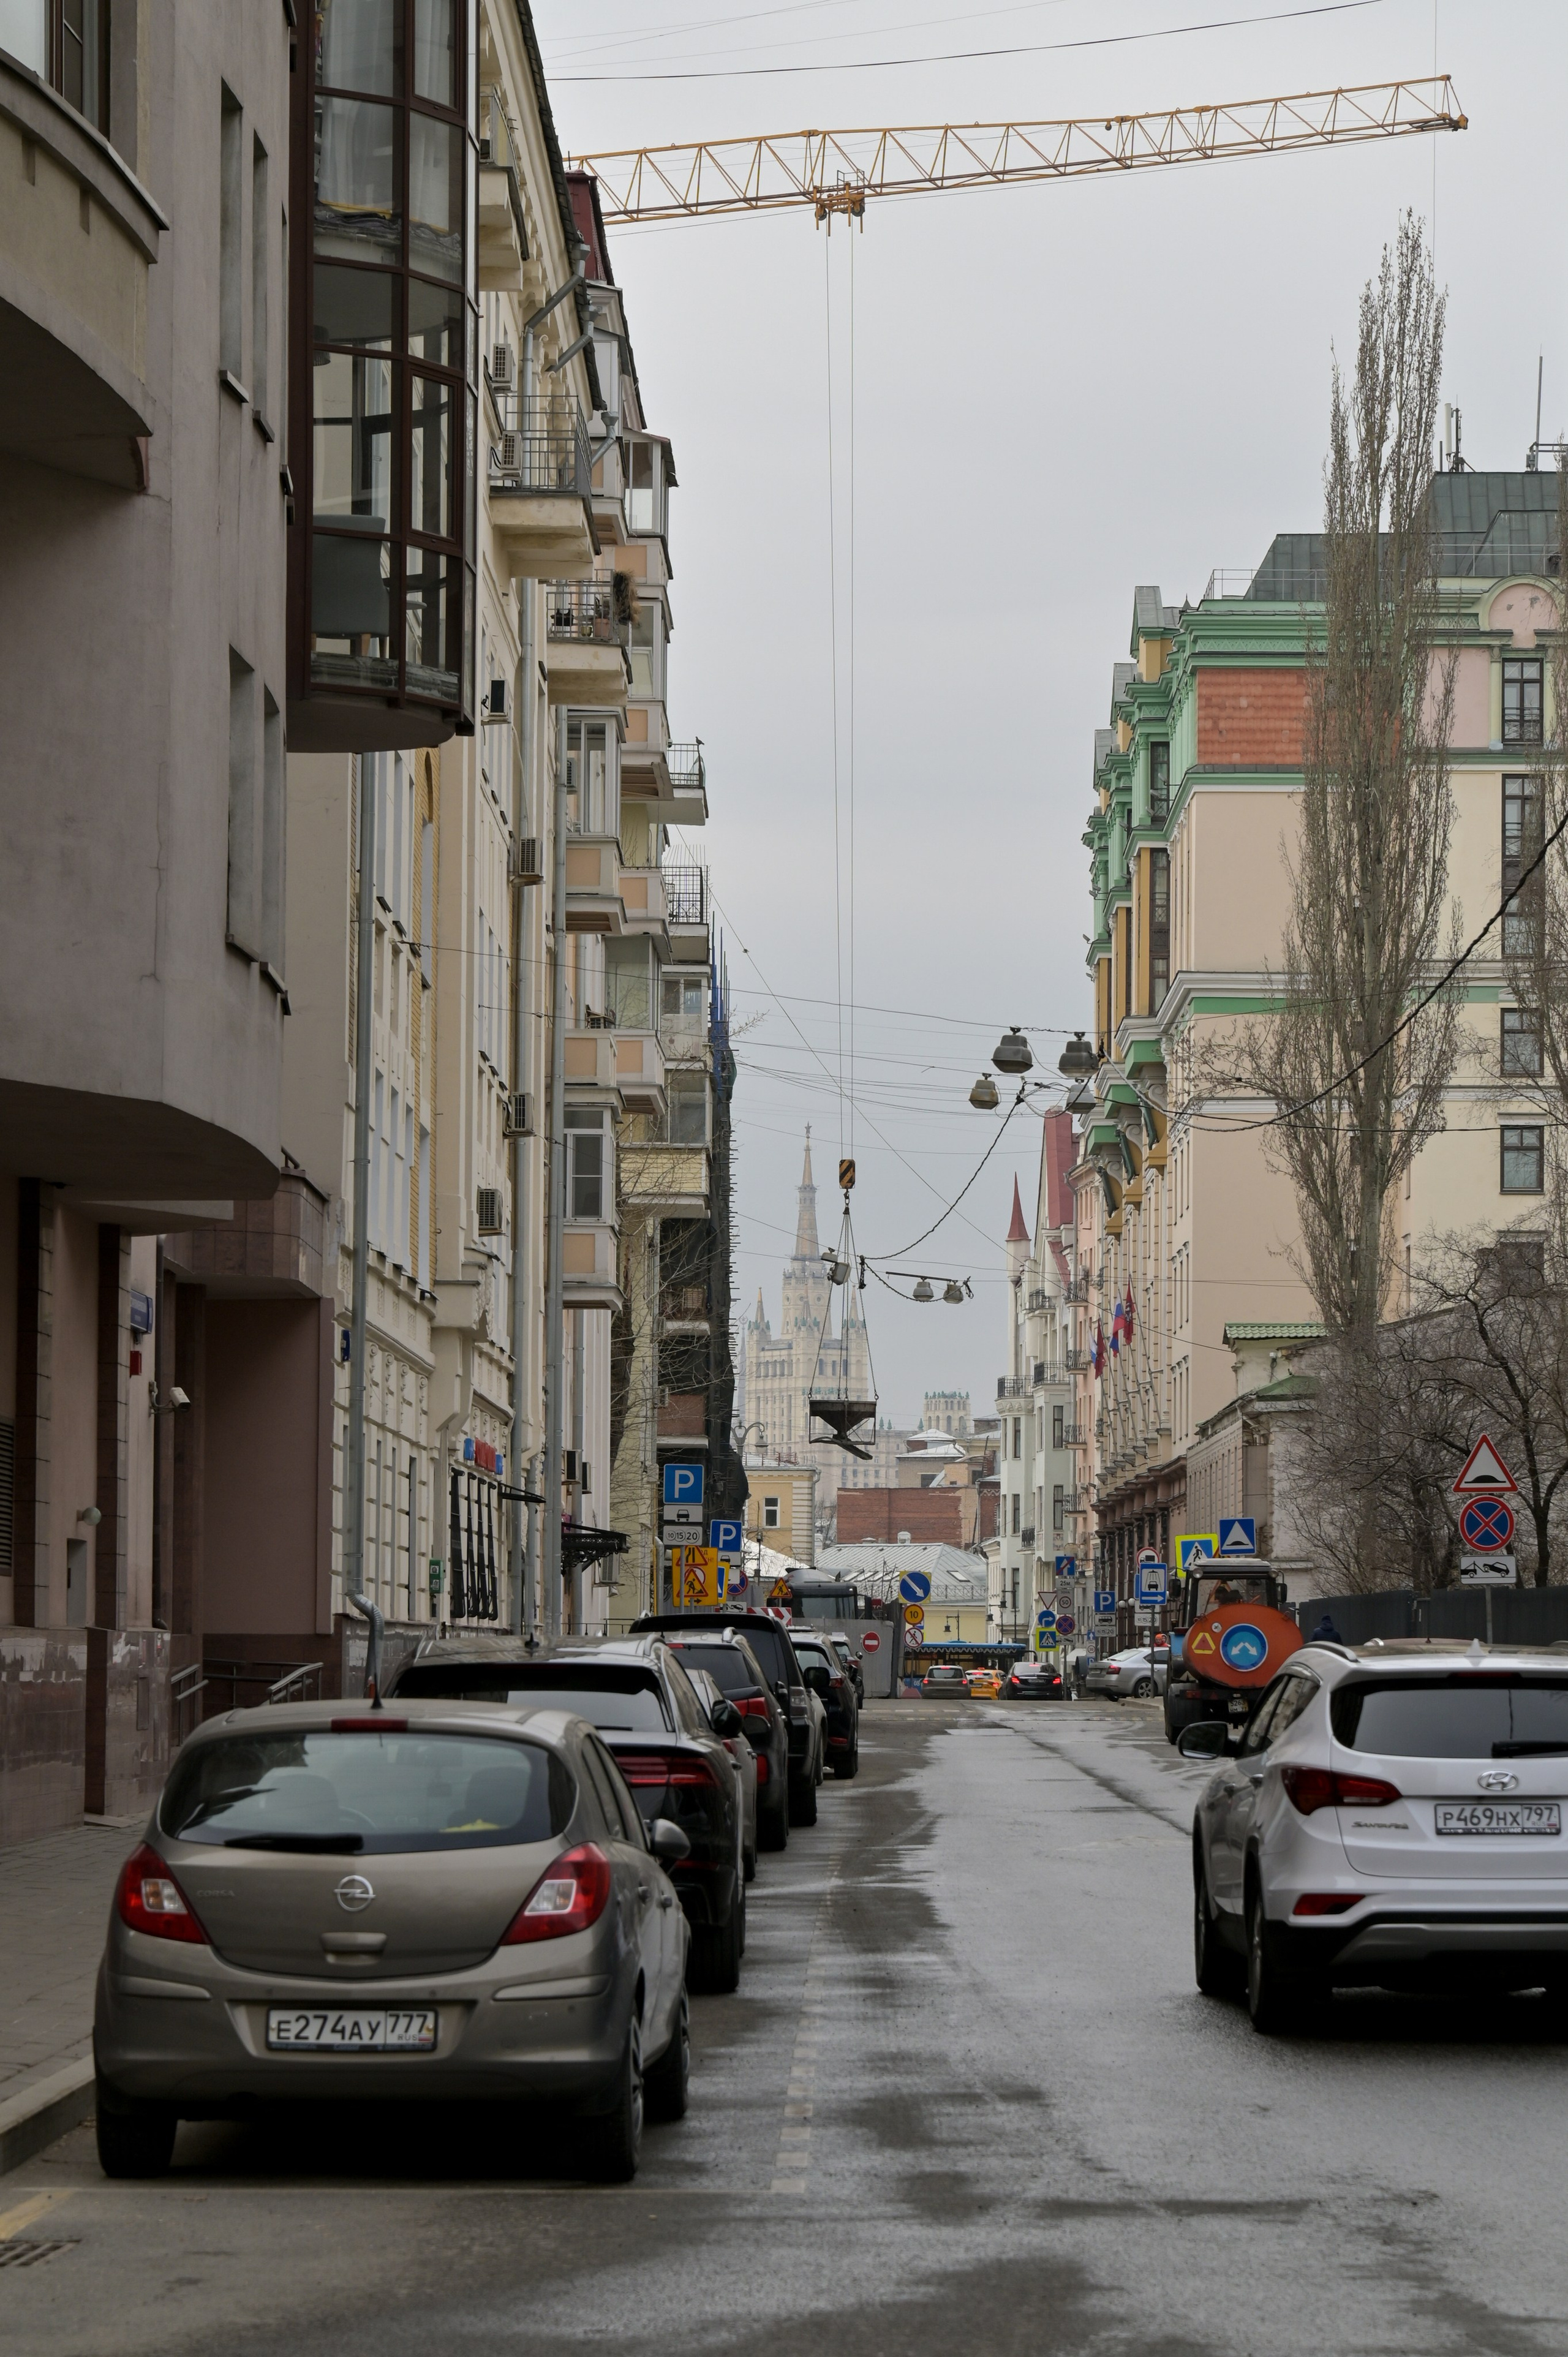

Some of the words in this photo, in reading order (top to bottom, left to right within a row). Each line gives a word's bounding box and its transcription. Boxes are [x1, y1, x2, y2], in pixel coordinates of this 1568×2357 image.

[674, 1469, 695, 1498] P
[719, 1524, 737, 1548] P
[1099, 1594, 1112, 1611] P
[1523, 1806, 1553, 1821] 797
[388, 2014, 428, 2034] 777
